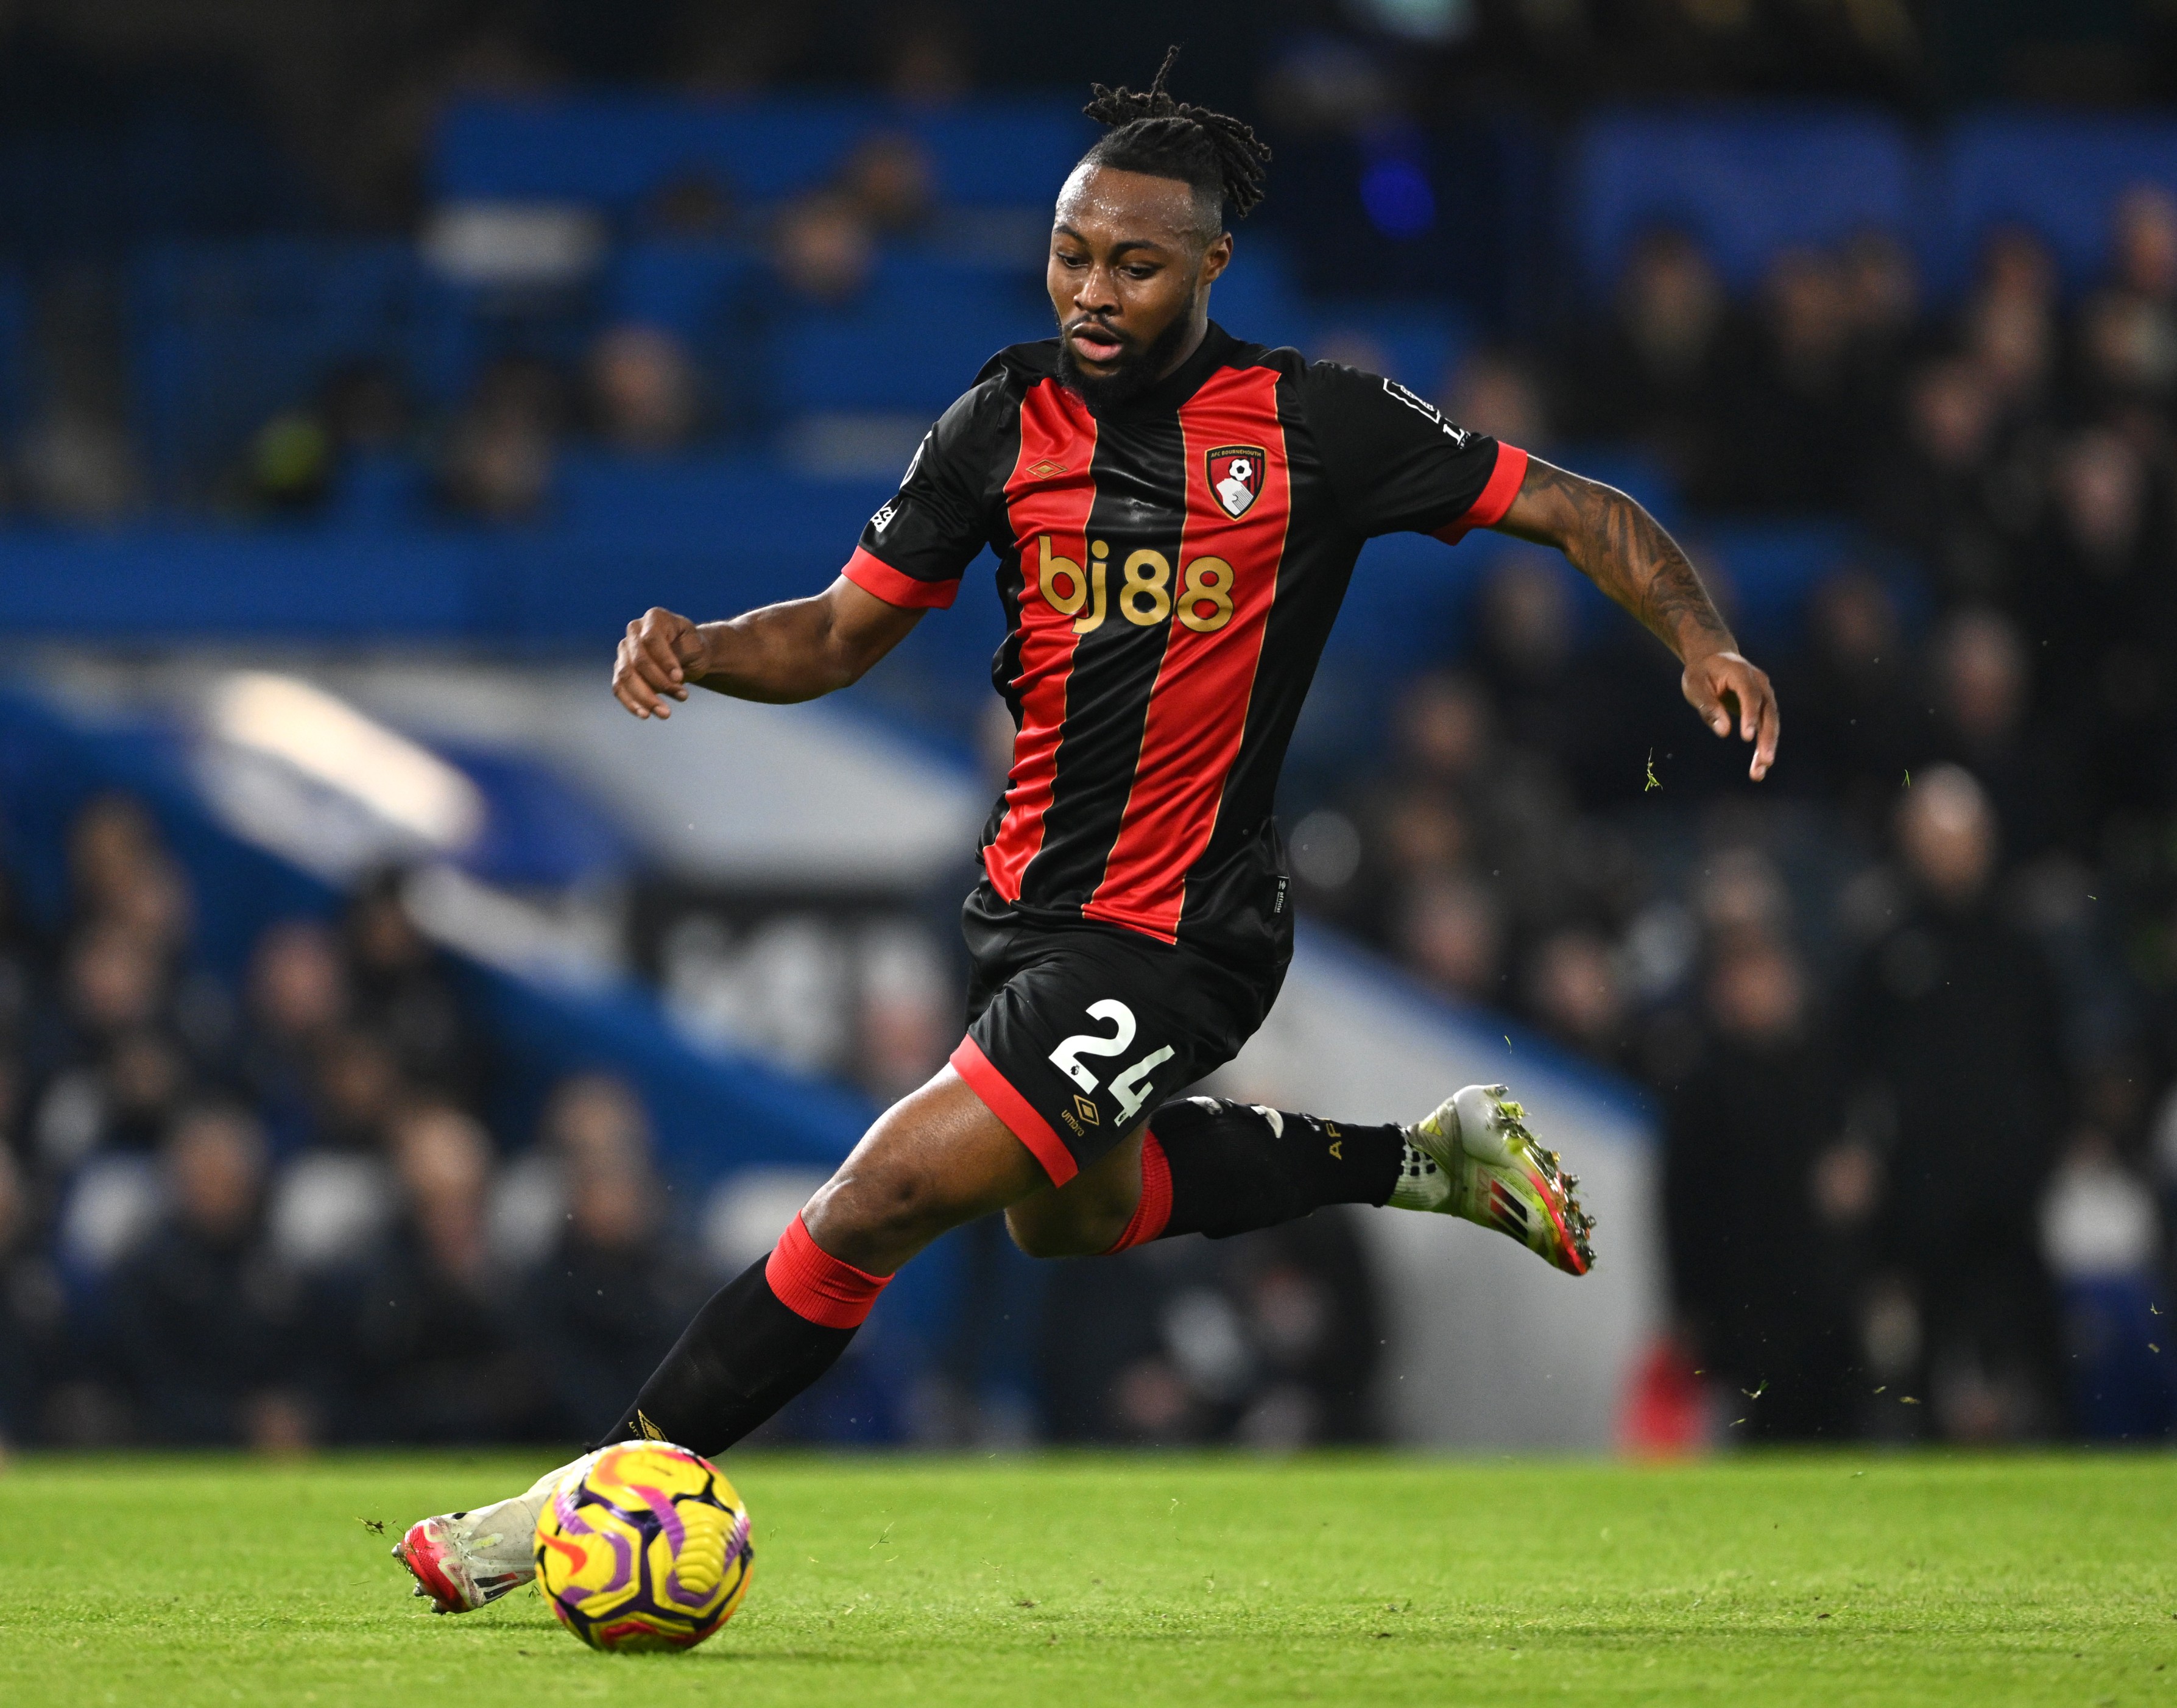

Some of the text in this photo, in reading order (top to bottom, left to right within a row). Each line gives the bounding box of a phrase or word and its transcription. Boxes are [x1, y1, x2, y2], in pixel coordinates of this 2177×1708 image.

[1039, 535, 1234, 633] bj88
[1048, 999, 1175, 1127] 24
[1061, 1109, 1084, 1137] umbro
[1325, 1122, 1343, 1160] AF
